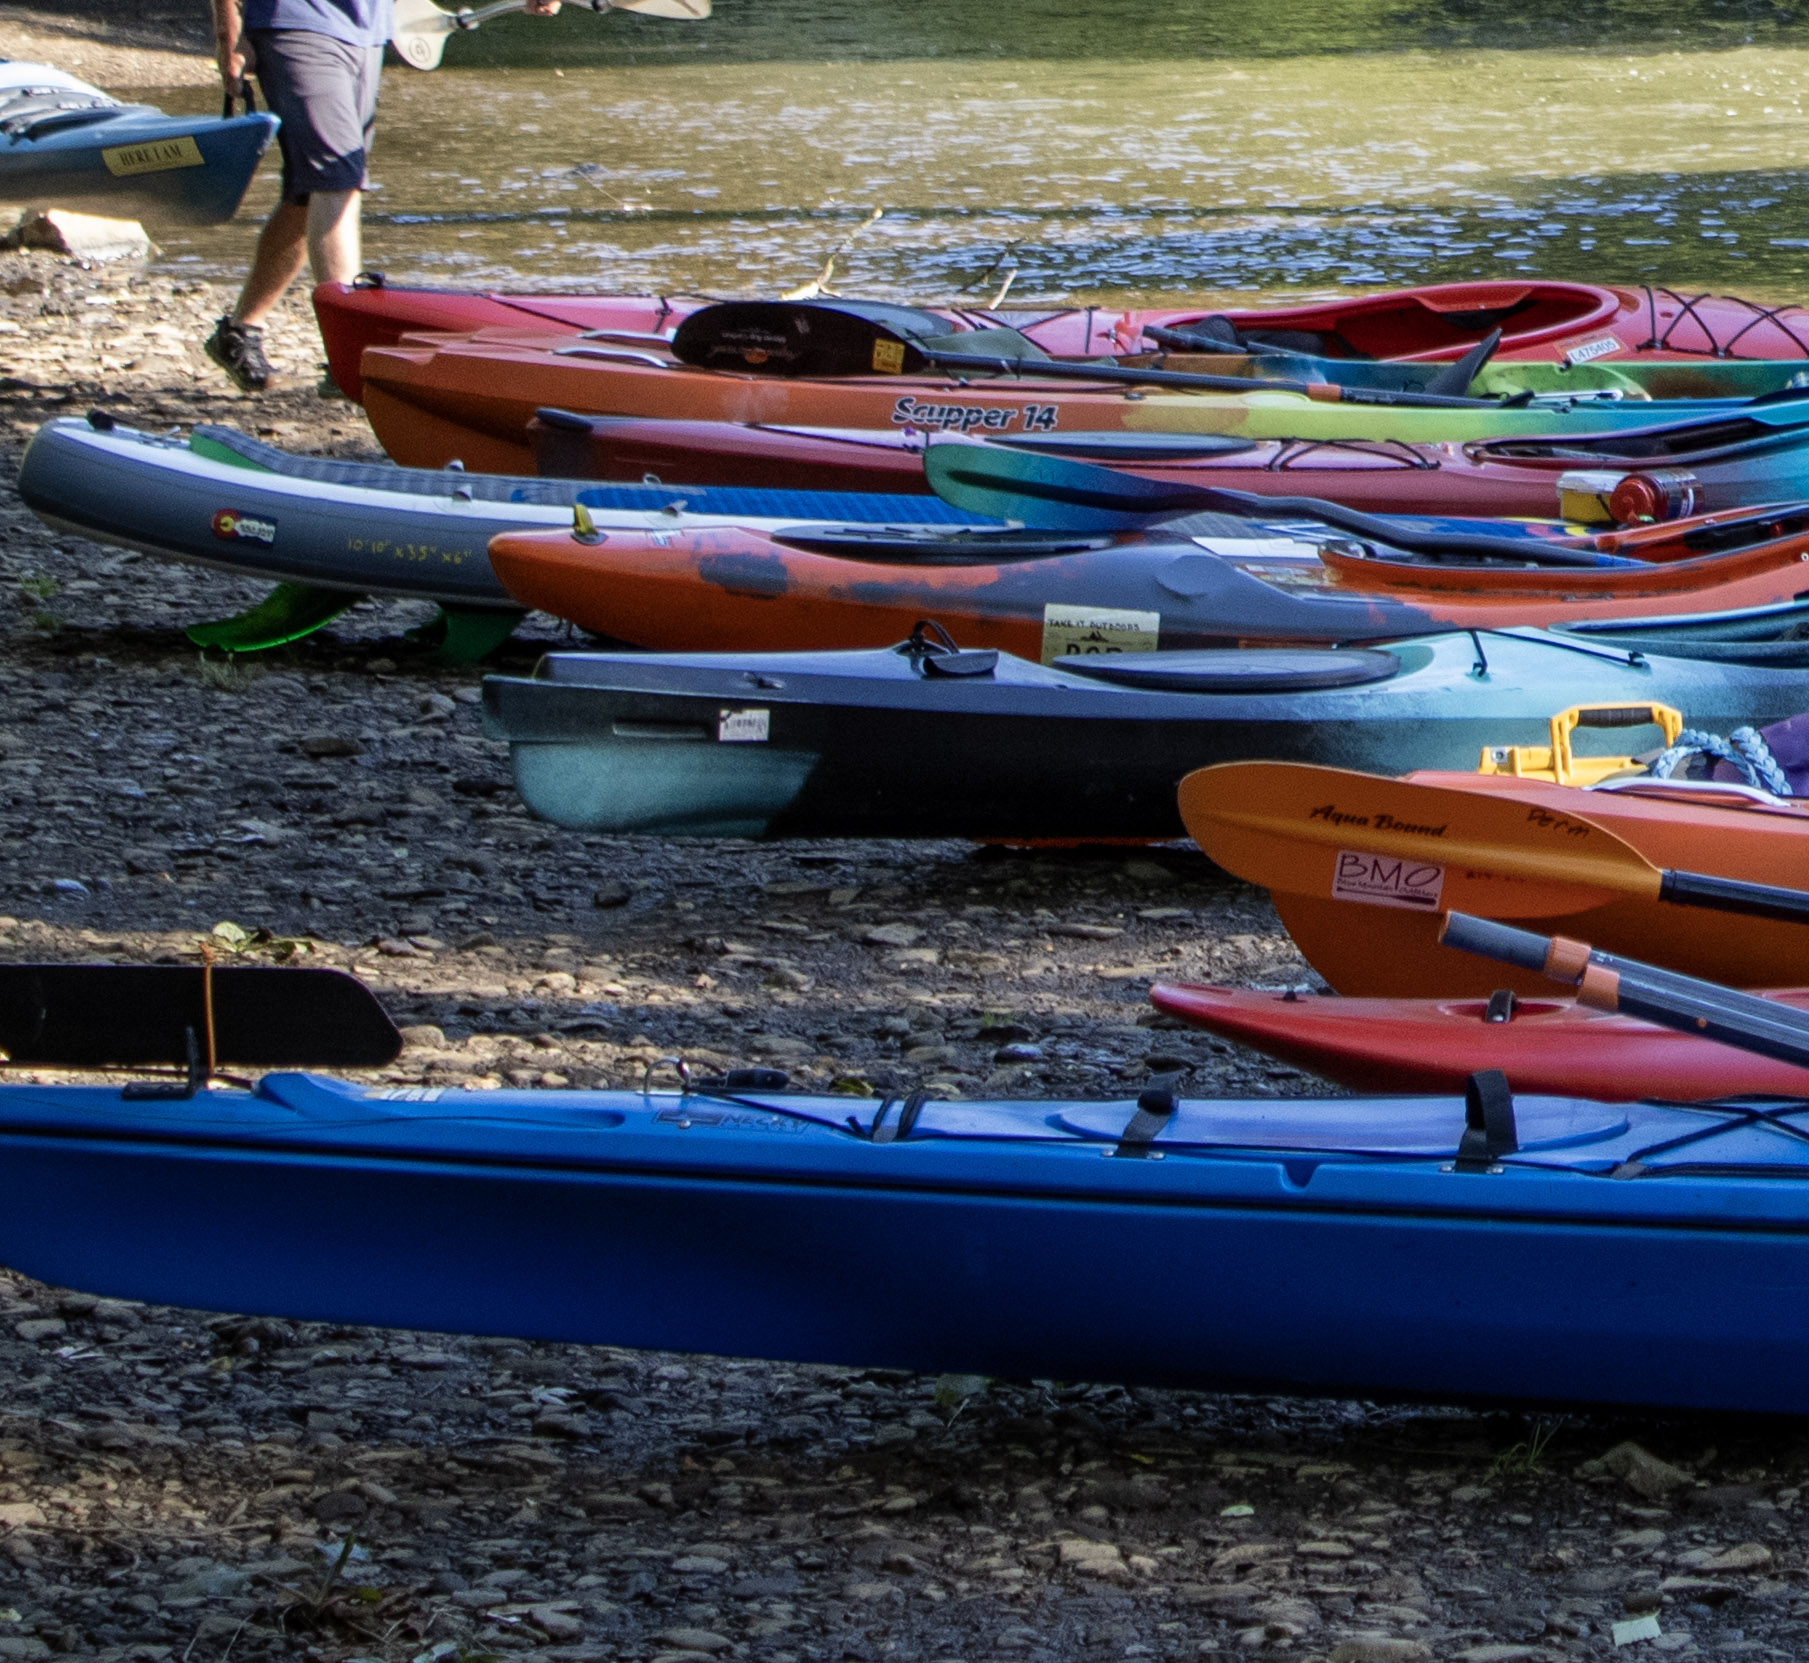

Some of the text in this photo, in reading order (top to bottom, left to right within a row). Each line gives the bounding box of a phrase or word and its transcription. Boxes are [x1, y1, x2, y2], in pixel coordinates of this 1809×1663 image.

[893, 397, 1057, 431] Scupper 14
[1309, 804, 1447, 837] Aqua Bound
[1338, 853, 1441, 890] BMO
